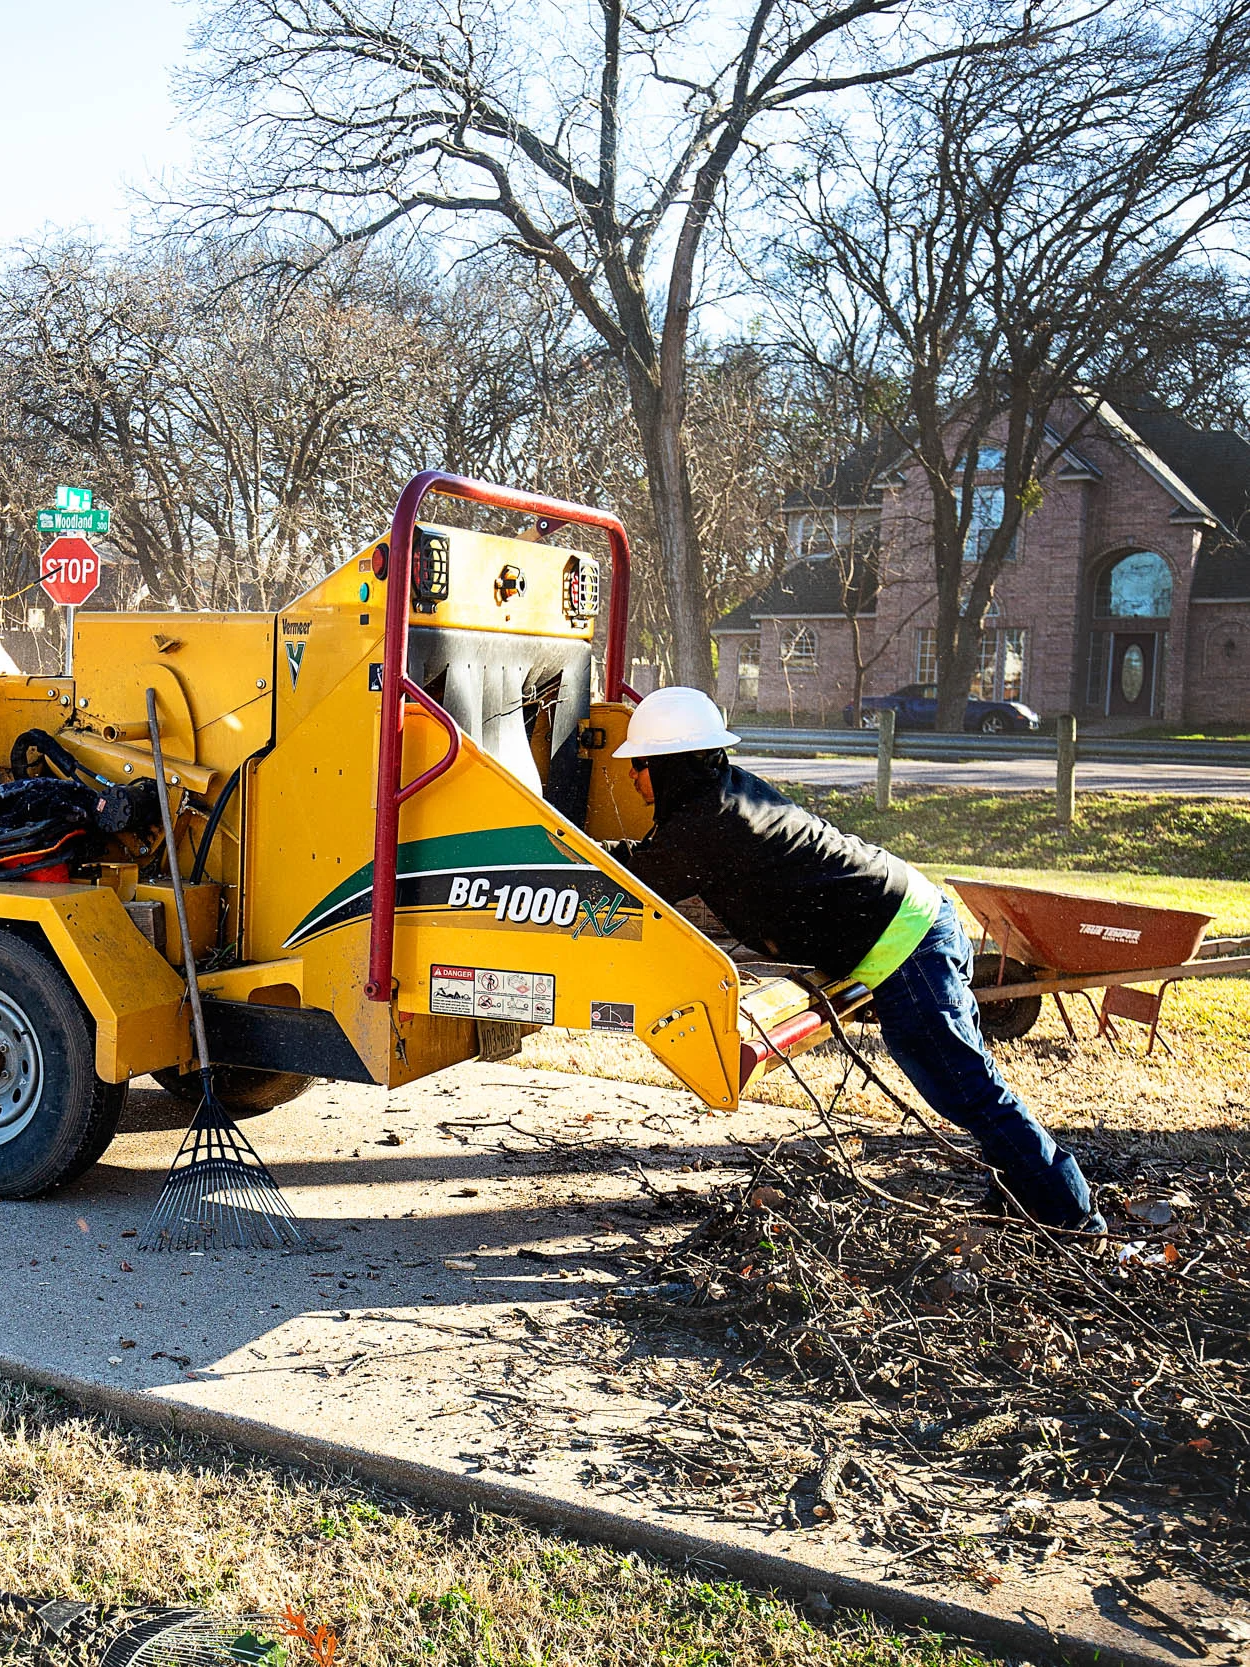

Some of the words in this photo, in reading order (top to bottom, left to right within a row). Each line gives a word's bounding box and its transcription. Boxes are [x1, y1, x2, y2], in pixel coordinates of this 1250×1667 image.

[55, 513, 93, 529] Woodland
[96, 521, 108, 530] 300
[45, 558, 95, 584] STOP
[448, 876, 491, 909] BC
[493, 884, 580, 927] 1000
[443, 968, 472, 978] DANGER
